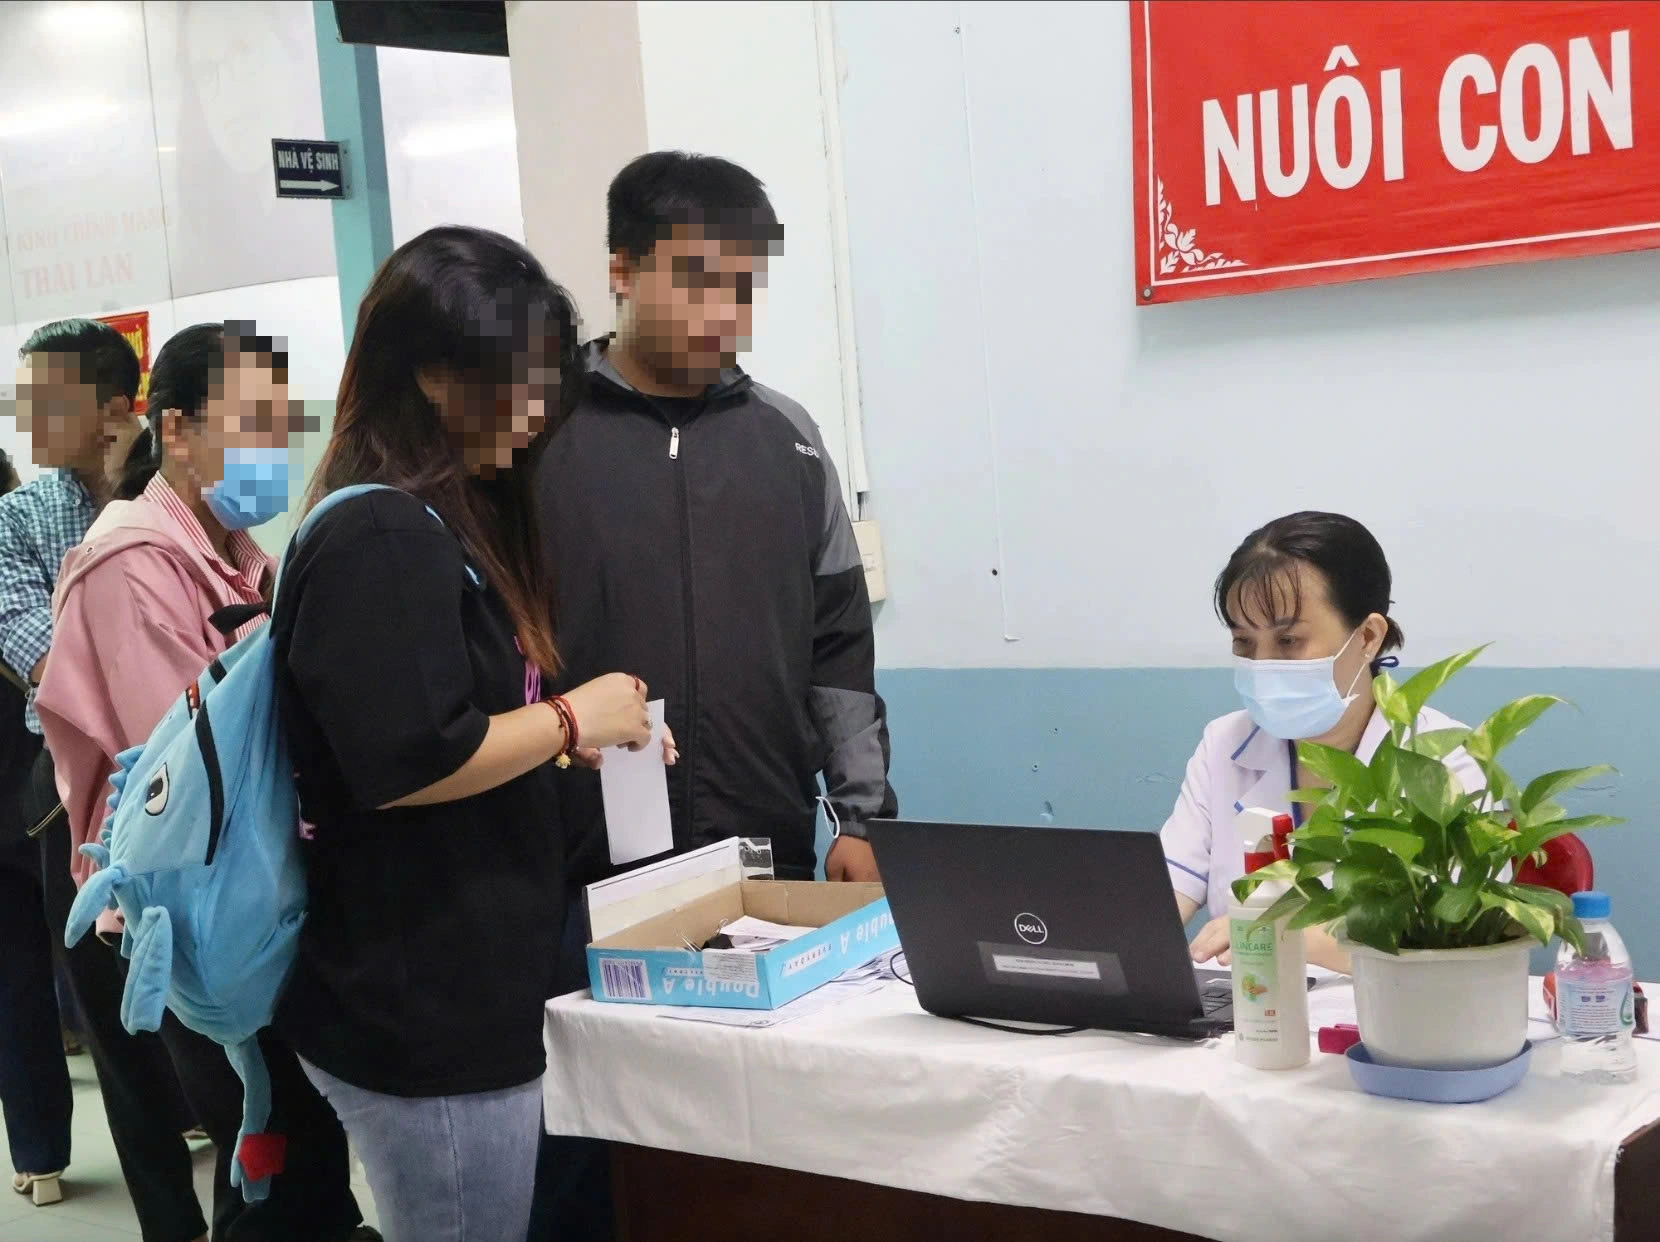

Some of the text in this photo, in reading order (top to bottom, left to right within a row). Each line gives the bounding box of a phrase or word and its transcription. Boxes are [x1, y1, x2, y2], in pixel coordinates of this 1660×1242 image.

[1202, 29, 1634, 208] NUÔI CON
[277, 146, 340, 174] NHÀ VỆ SINH
[1018, 923, 1045, 934] DELL
[840, 931, 850, 955] A
[662, 978, 760, 998] Double A
